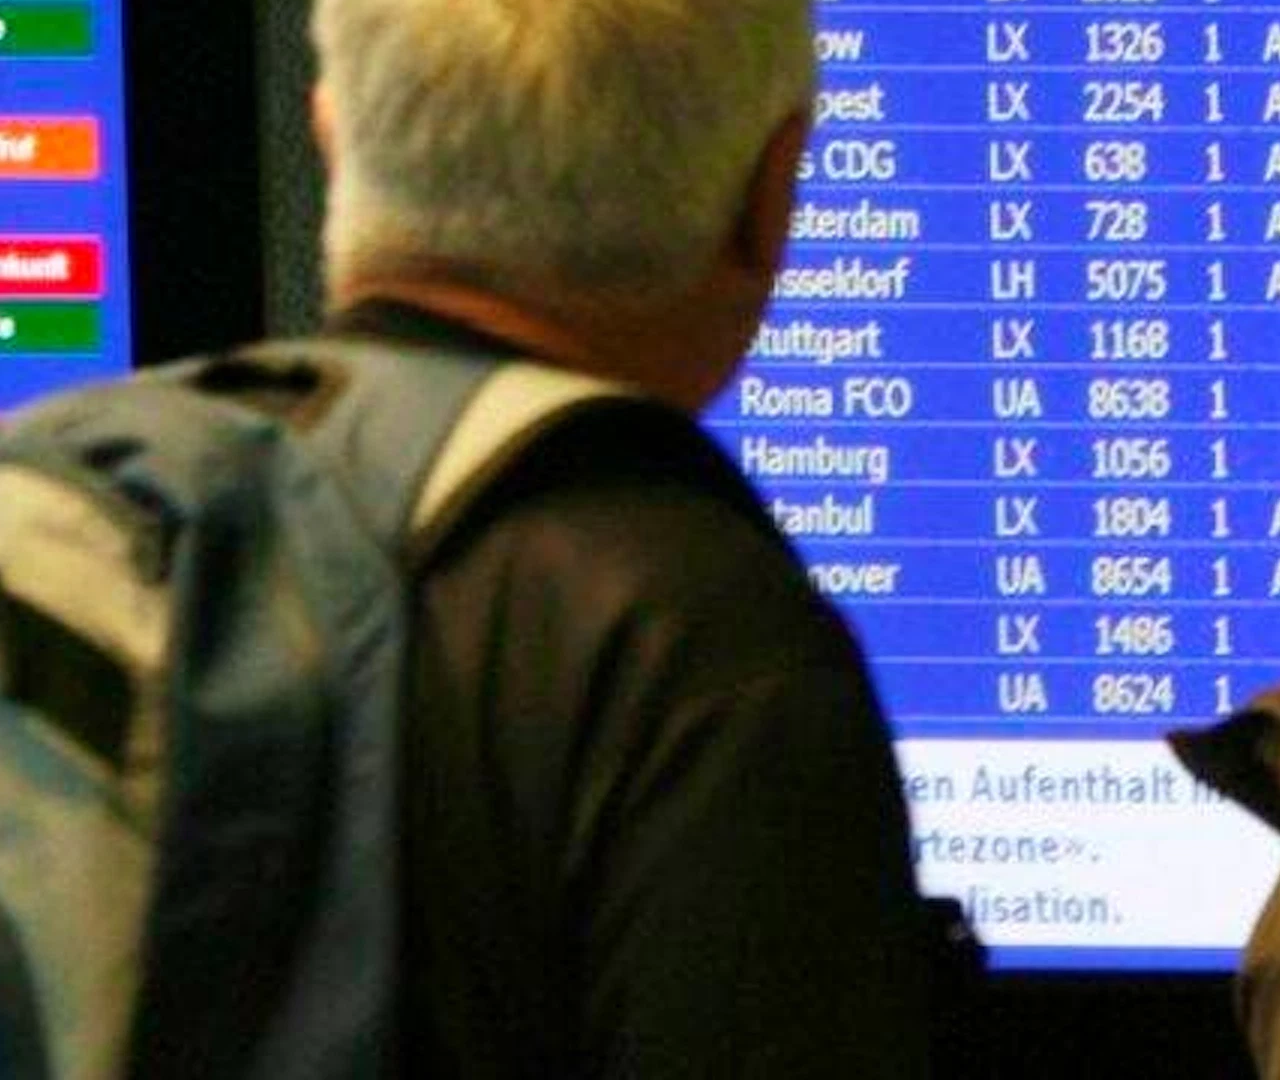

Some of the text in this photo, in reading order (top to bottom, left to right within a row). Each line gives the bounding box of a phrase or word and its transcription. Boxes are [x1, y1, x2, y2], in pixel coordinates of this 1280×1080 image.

[741, 378, 1227, 419] Roma FCO UA 8638 1
[742, 437, 1228, 484] Hamburg LX 1056 1
[972, 765, 1179, 804] Aufenthalt
